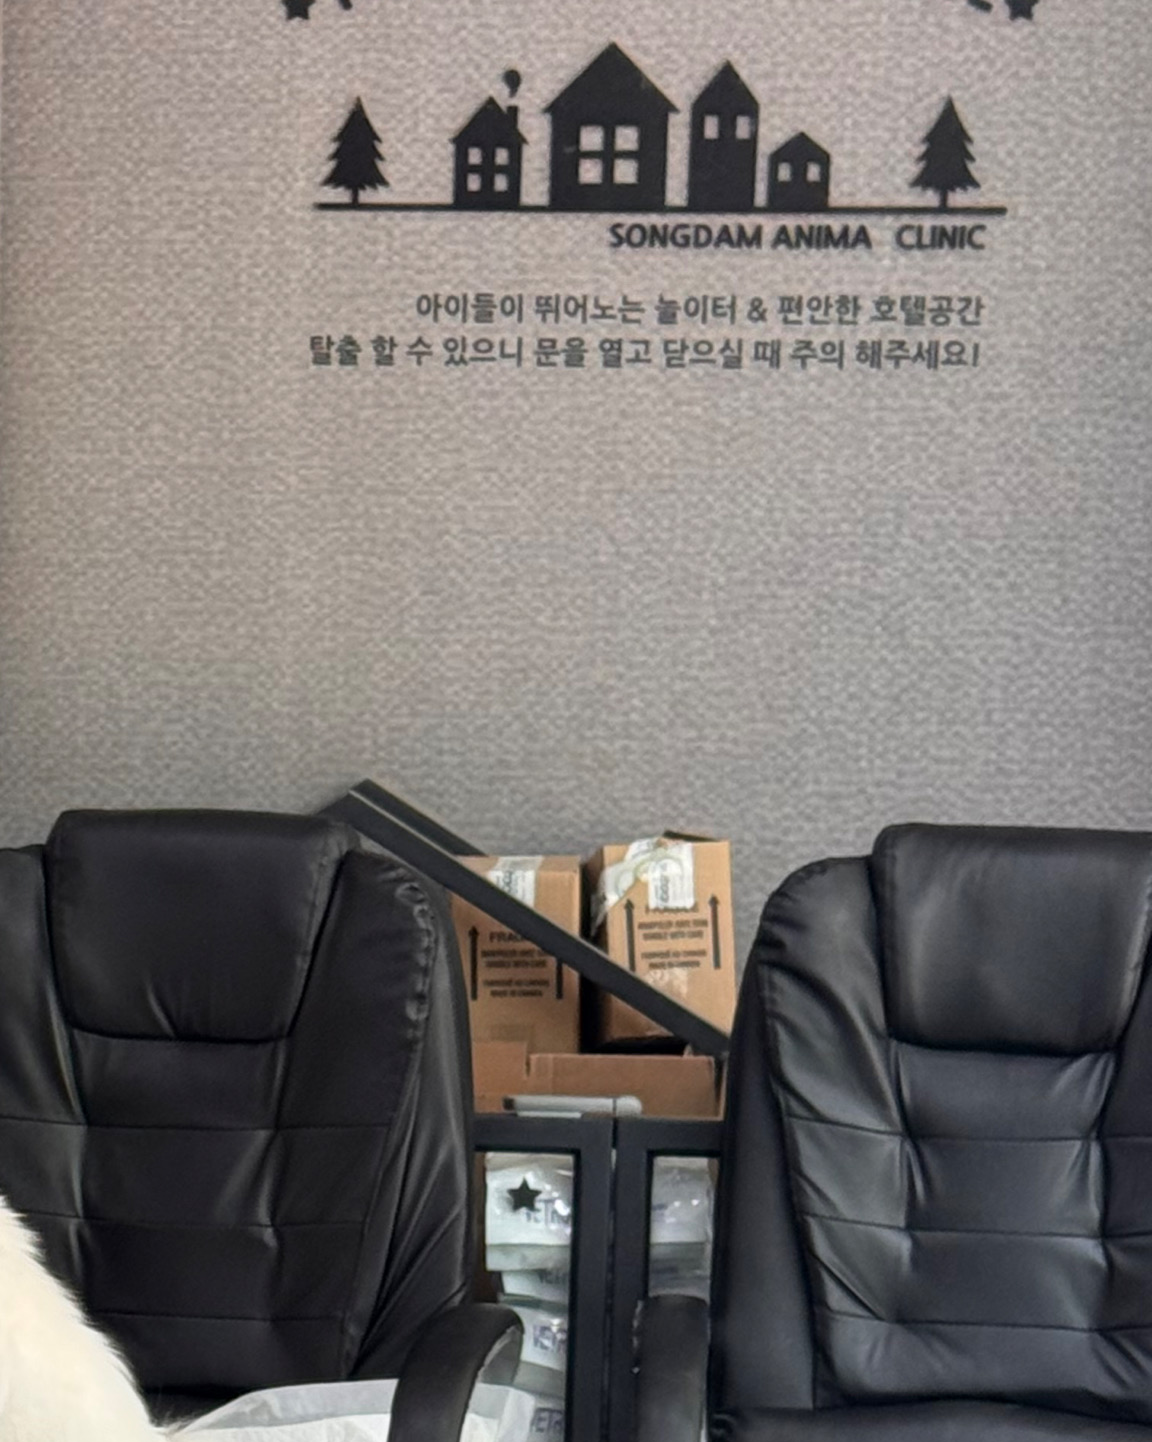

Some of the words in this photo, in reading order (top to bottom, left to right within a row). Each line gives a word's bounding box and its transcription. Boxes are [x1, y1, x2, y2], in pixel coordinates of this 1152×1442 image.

[608, 223, 763, 250] SONGDAM
[771, 224, 873, 250] ANIMA
[895, 225, 987, 250] CLINIC
[415, 293, 524, 324] 아이들이
[534, 293, 646, 325] 뛰어노는
[654, 294, 737, 325] 놀이터
[747, 297, 768, 323] &
[777, 295, 862, 326] 편안한
[870, 295, 986, 327] 호텔공간
[309, 335, 363, 367] 탈출
[370, 335, 399, 367] 할
[406, 336, 434, 366] 수
[442, 336, 524, 368] 있으니
[534, 336, 589, 368] 문을
[598, 337, 653, 369] 열고
[662, 338, 744, 369] 닫으실
[753, 339, 782, 370] 때
[790, 339, 846, 370] 주의
[855, 339, 980, 371] 해주세요!
